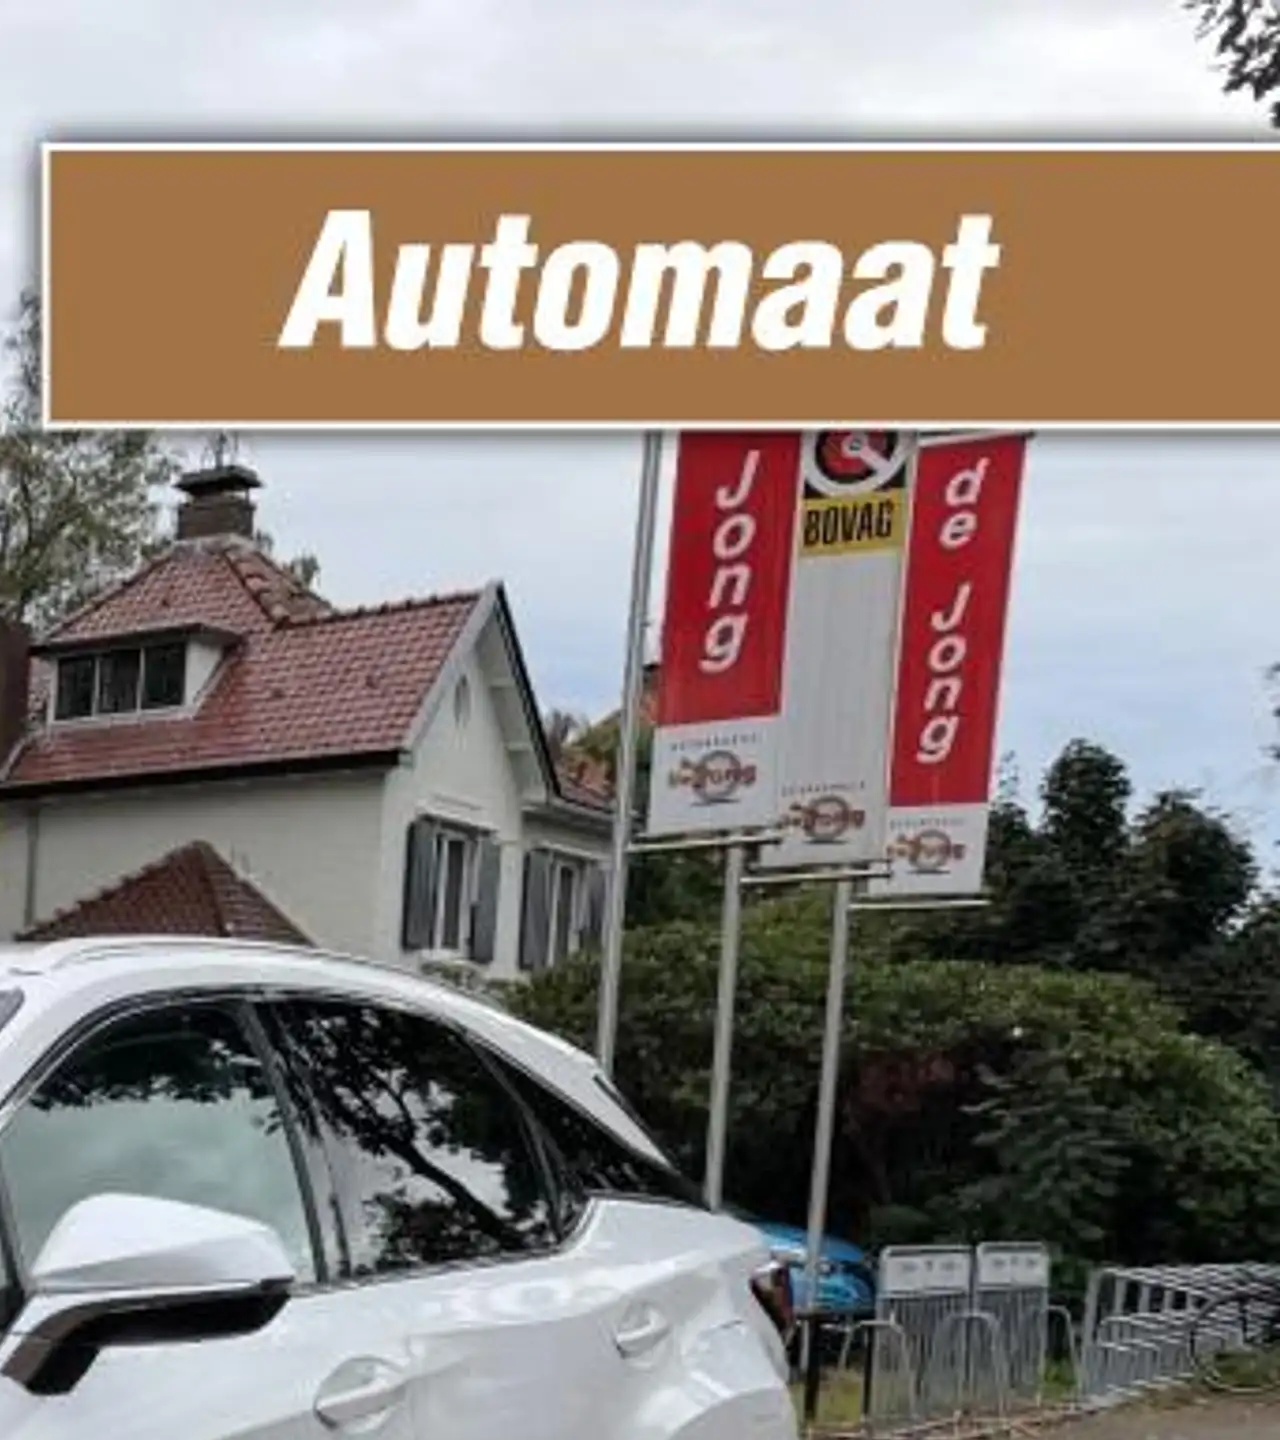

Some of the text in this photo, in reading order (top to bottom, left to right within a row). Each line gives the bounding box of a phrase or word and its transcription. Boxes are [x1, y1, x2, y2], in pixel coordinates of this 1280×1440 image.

[699, 449, 761, 673] Jong
[802, 499, 896, 547] BOVAG
[940, 456, 990, 549] de
[916, 582, 972, 763] Jong
